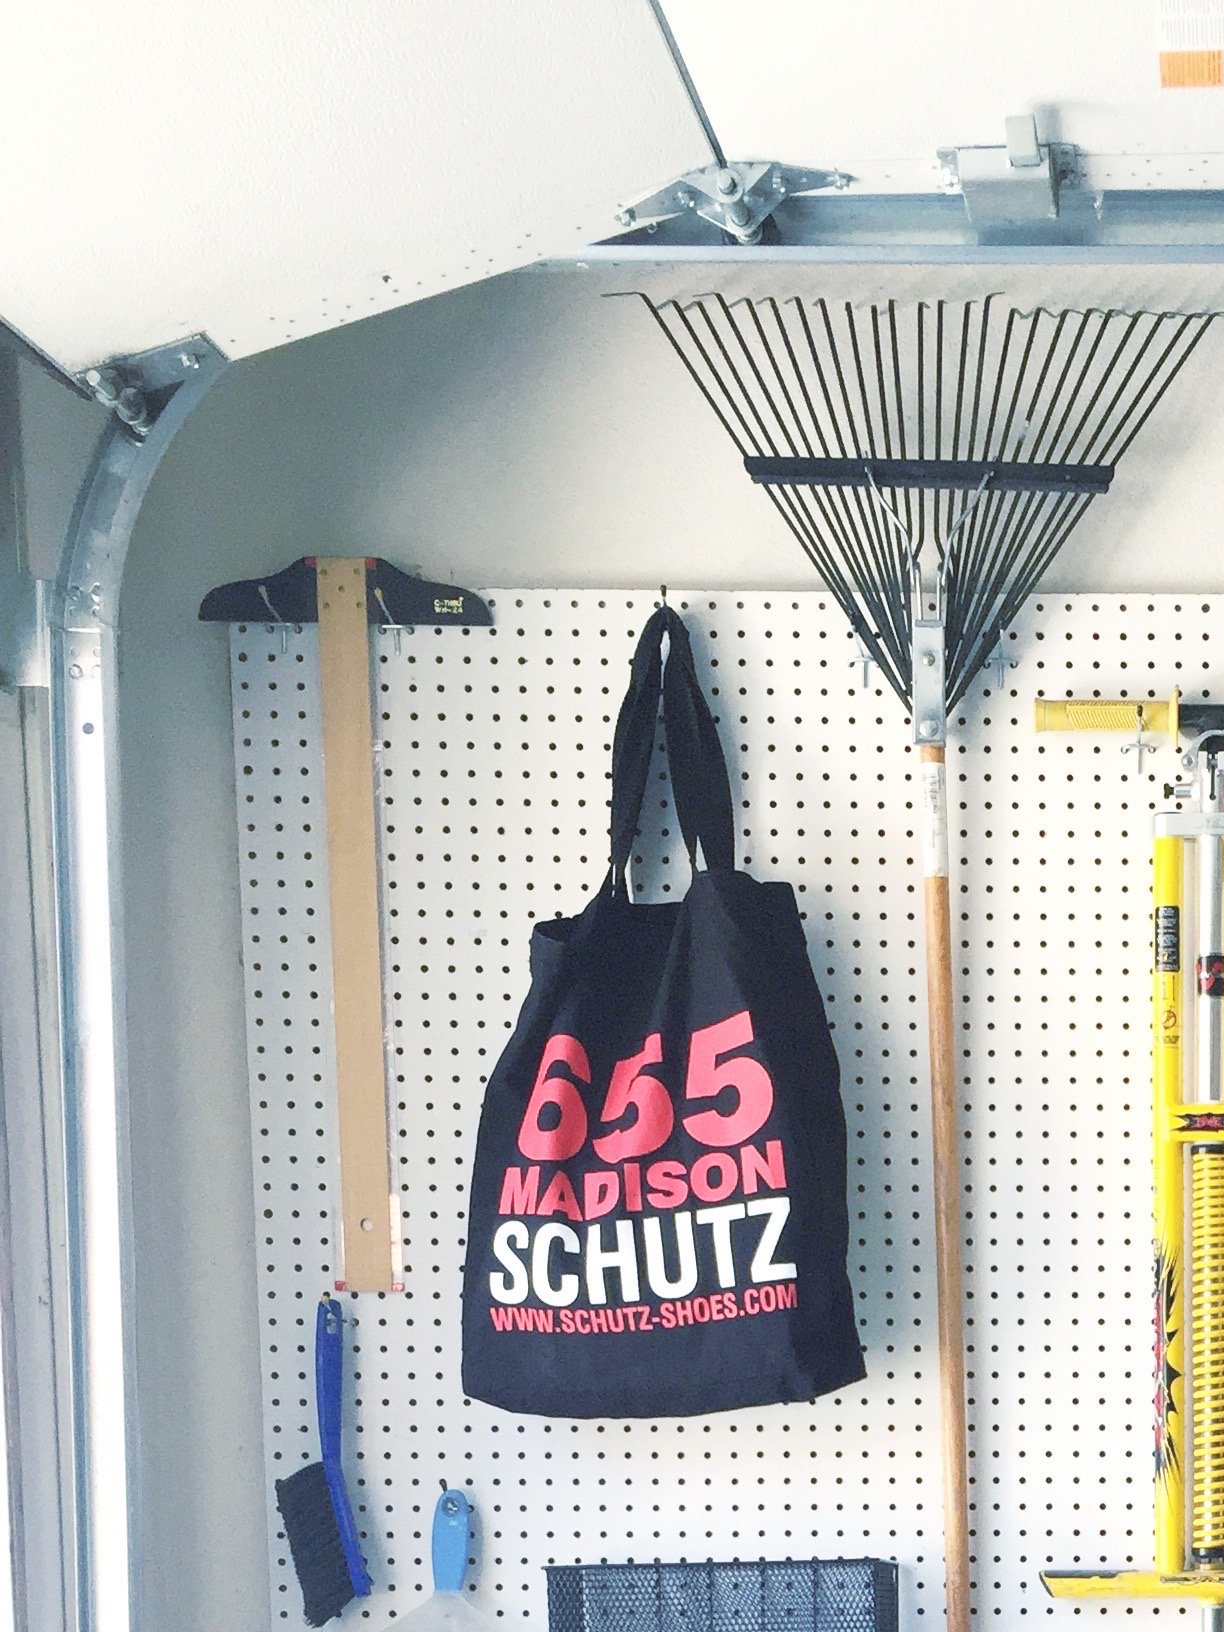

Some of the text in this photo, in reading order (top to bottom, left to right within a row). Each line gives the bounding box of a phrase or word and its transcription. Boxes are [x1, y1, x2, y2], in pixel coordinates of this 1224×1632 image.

[517, 1011, 774, 1165] 655
[498, 1139, 788, 1222] MADISON
[489, 1196, 798, 1306] SCHUTZ
[489, 1283, 799, 1335] WWW.SCHUTZ-SHOES.COM
